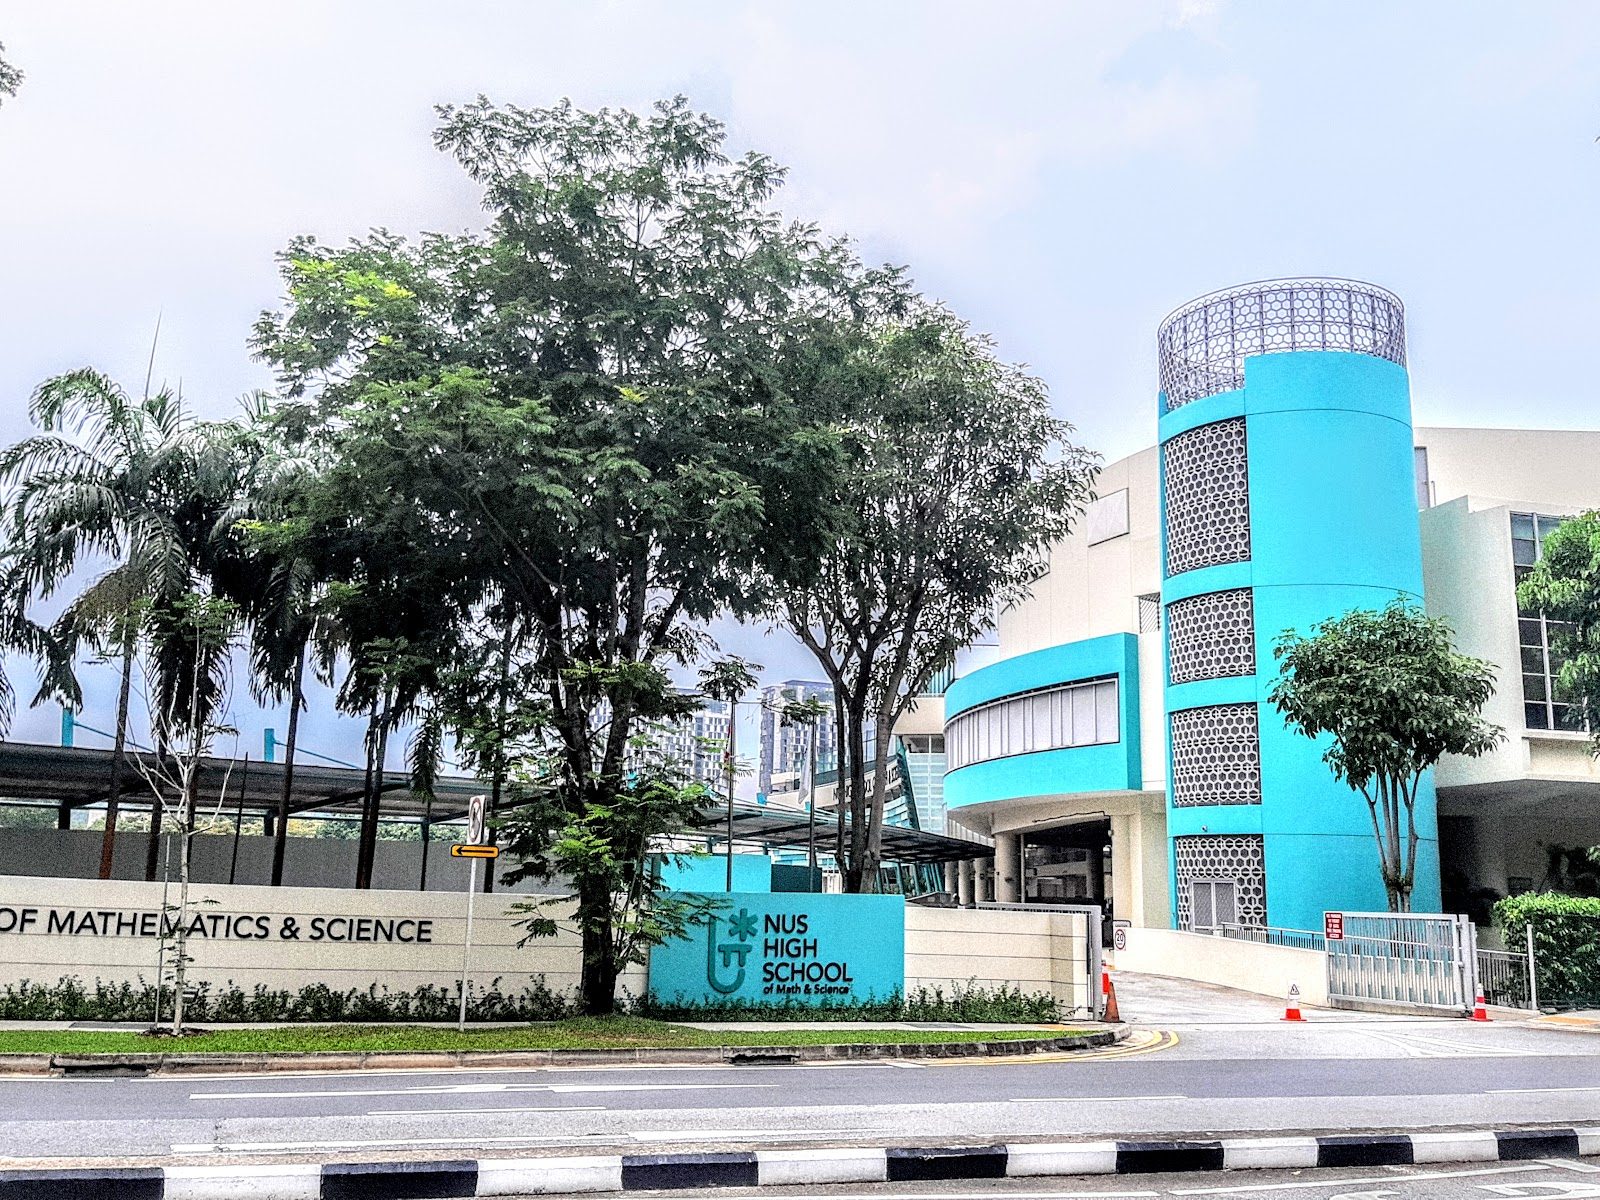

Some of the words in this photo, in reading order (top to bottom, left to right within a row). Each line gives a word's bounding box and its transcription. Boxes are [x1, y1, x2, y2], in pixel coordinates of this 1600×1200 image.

[0, 908, 38, 932] OF
[47, 910, 269, 939] MATHEMATICS
[280, 917, 300, 940] &
[309, 918, 433, 942] SCIENCE
[765, 914, 808, 934] NUS
[764, 938, 817, 958] HIGH
[762, 962, 853, 982] SCHOOL
[763, 983, 774, 994] of
[776, 984, 801, 994] Math
[803, 984, 812, 994] &
[814, 984, 849, 994] Science
